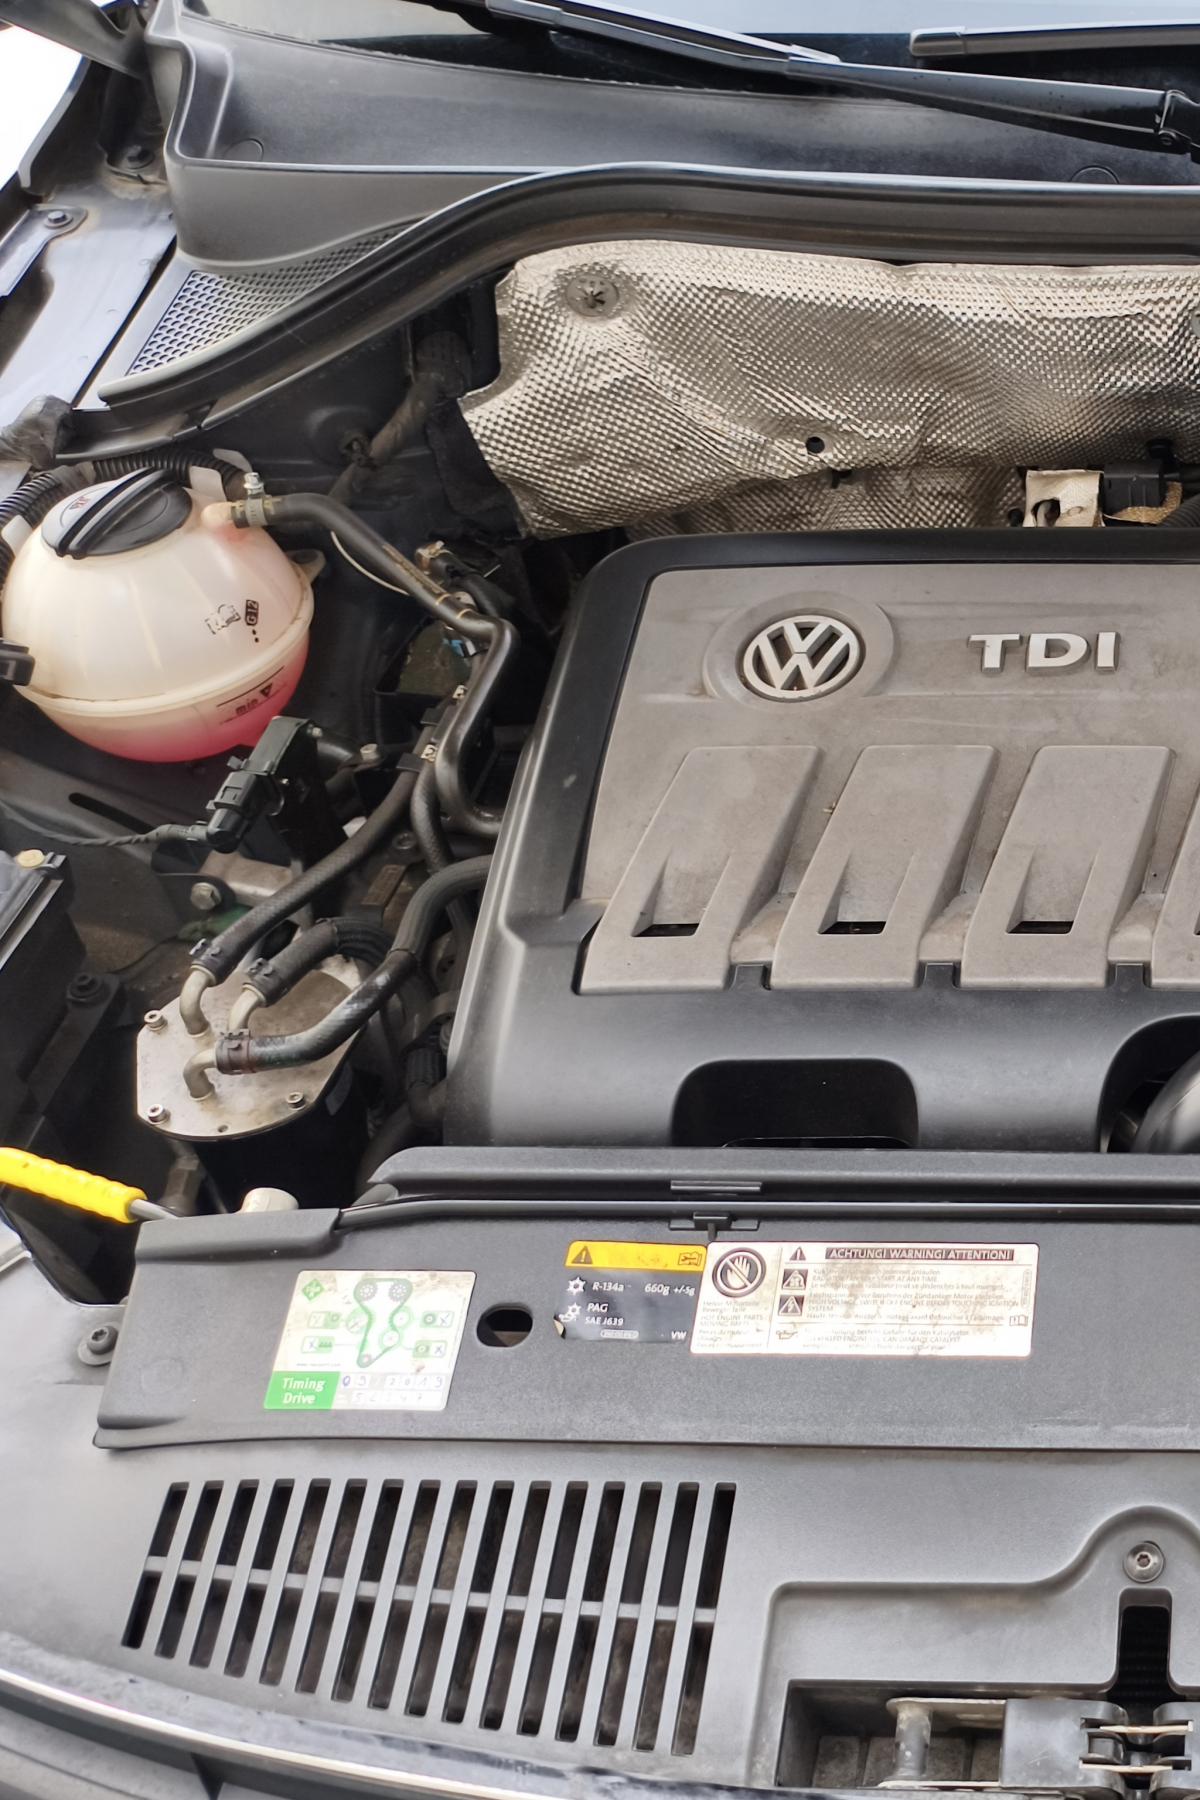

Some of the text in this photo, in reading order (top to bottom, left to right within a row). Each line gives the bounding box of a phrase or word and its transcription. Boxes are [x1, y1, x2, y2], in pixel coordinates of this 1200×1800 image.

[967, 631, 1121, 673] TDI
[236, 698, 258, 716] min
[830, 1248, 1011, 1261] ACHTUNG! WARNING! ATTENTION!
[592, 1281, 625, 1292] R-134a
[644, 1283, 670, 1296] 660g
[587, 1303, 609, 1313] PAG
[584, 1316, 624, 1327] SAE J639
[671, 1331, 687, 1340] VW
[281, 1376, 326, 1392] Timing
[282, 1392, 316, 1405] Drive
